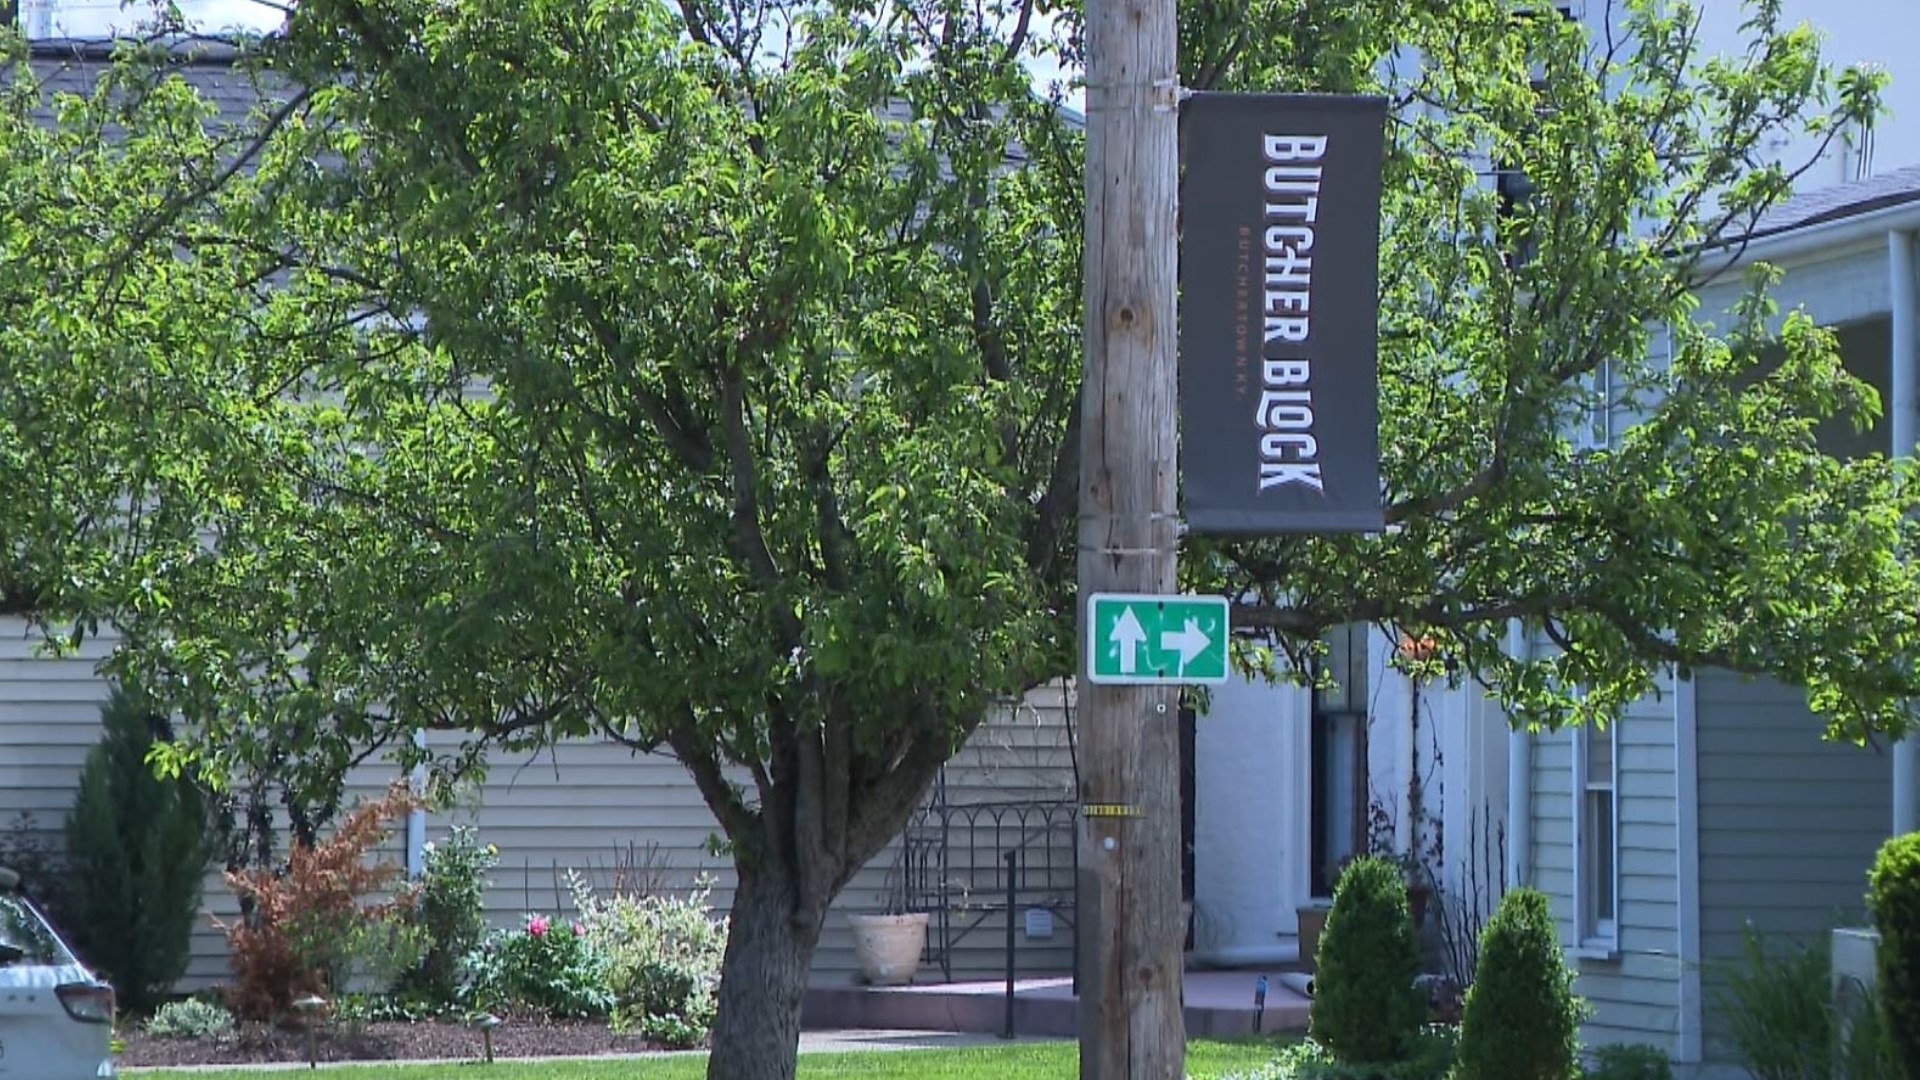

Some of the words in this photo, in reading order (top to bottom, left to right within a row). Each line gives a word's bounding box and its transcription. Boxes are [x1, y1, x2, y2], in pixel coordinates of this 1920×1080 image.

[1236, 226, 1250, 367] BUTCHERTOWN
[1263, 135, 1327, 343] BUTCHER
[1256, 359, 1323, 490] BLOCK
